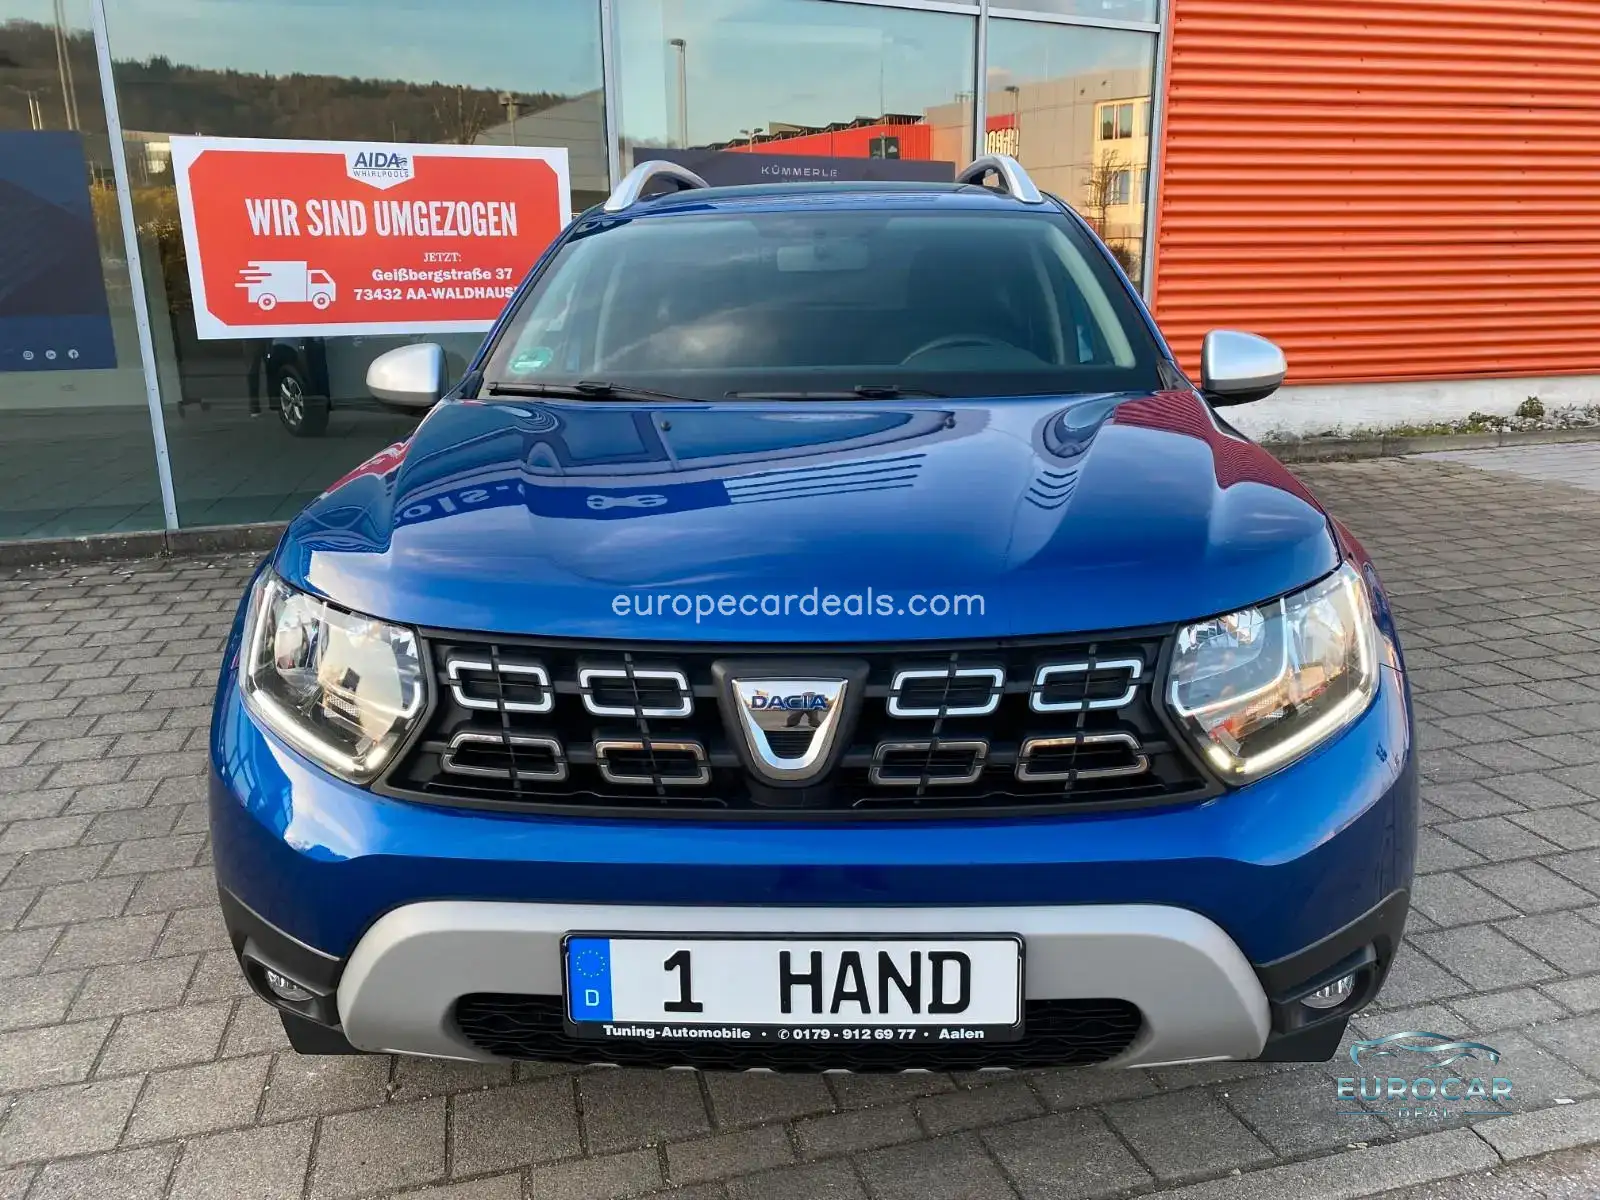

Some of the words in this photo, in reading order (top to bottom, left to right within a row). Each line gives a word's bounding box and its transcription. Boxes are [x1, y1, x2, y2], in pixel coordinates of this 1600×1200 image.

[354, 152, 401, 168] AIDA
[353, 170, 409, 178] WHIRLPOOLS
[761, 164, 838, 177] KÜMMERLE
[245, 198, 300, 237] WIR
[305, 199, 367, 237] SIND
[373, 200, 518, 237] UMGEZOGEN
[423, 252, 462, 263] JETZT:
[372, 267, 491, 283] Geißbergstraße
[495, 268, 513, 280] 37
[353, 288, 402, 301] 73432
[406, 286, 518, 300] AA-WALDHAUS
[751, 694, 827, 710] DACIA
[664, 950, 704, 1013] 1
[779, 950, 972, 1014] HAND
[585, 989, 600, 1007] D
[603, 1024, 751, 1040] Tuning-Automobile
[793, 1028, 831, 1040] 0179
[842, 1028, 871, 1040] 912
[874, 1028, 894, 1040] 69
[897, 1028, 917, 1040] 77
[938, 1027, 985, 1040] Aalen
